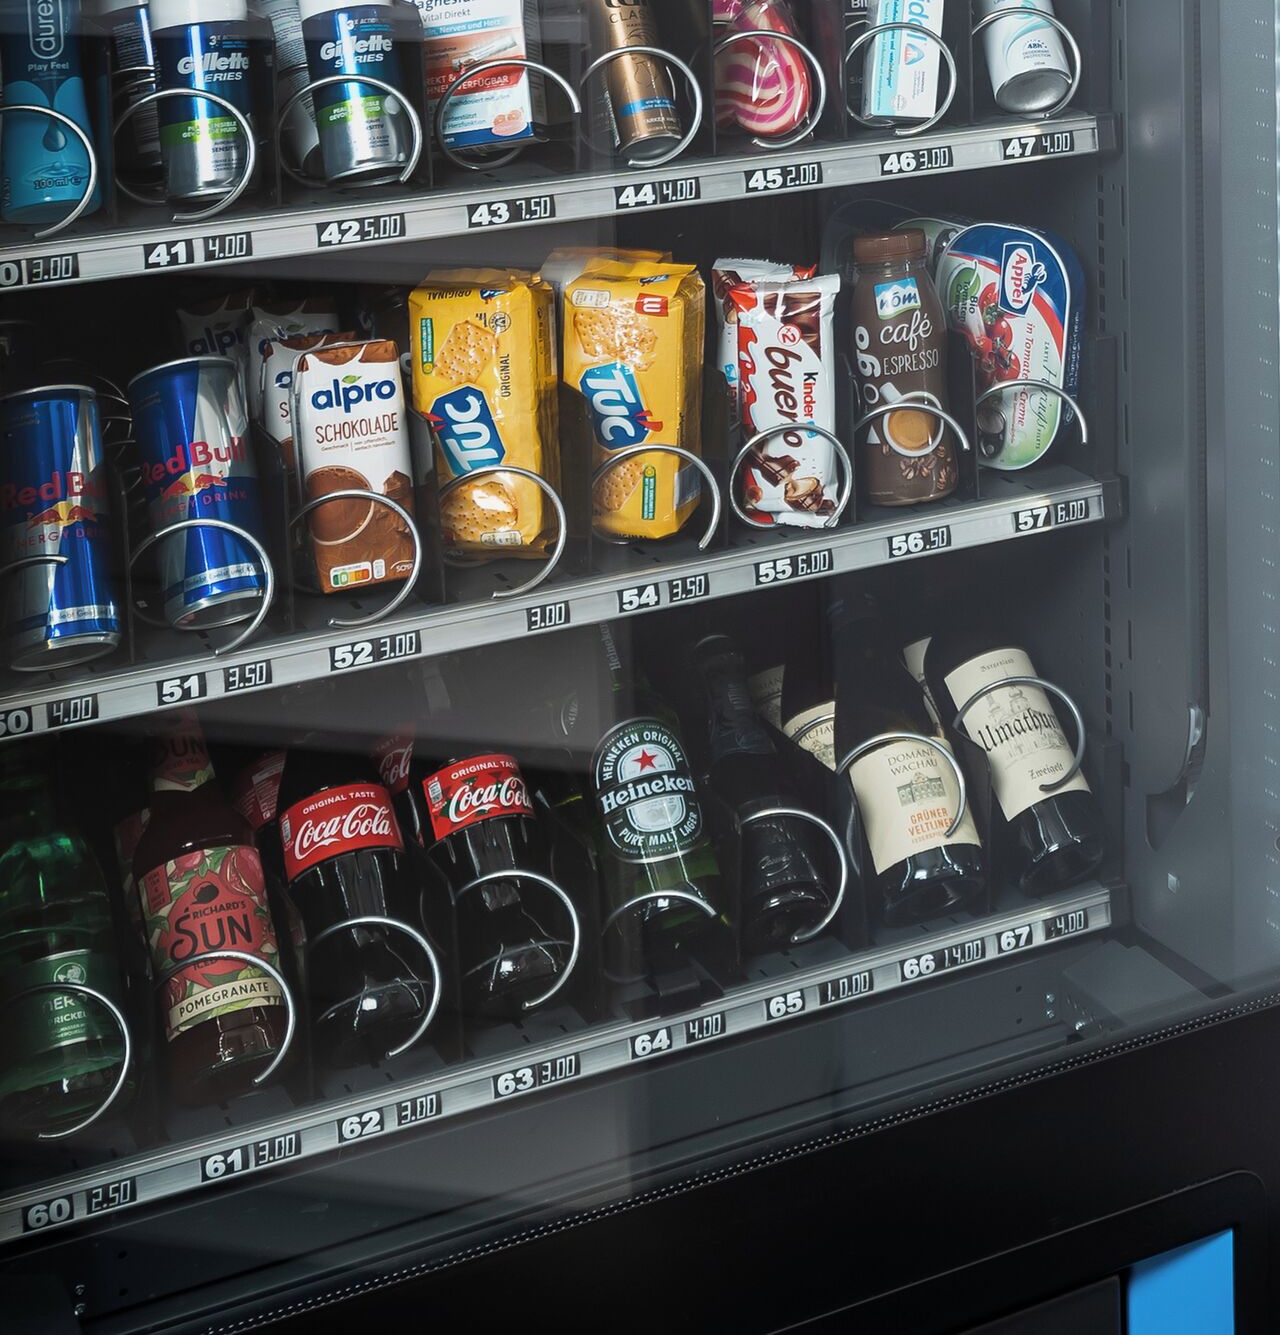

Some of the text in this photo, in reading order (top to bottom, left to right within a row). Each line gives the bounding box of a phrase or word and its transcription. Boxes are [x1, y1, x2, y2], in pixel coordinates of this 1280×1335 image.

[422, 8, 471, 22] Vital Direkt
[440, 24, 465, 35] Nerven
[28, 60, 69, 73] Play Feel
[1005, 133, 1071, 158] 47 4.00
[883, 148, 950, 174] 46 3.00
[34, 178, 54, 189] 100
[748, 170, 784, 189] 45
[618, 179, 696, 207] 44 4.00
[471, 203, 510, 226] 43
[320, 215, 400, 244] 42 5.00
[148, 234, 247, 267] 41 4.00
[1011, 253, 1029, 306] Appel
[969, 295, 979, 315] Bio
[880, 309, 933, 351] café
[501, 353, 511, 398] ORIGINAL
[884, 348, 939, 377] ESPRESSO
[311, 377, 396, 413] alpro
[315, 412, 399, 444] SCHOKOLADE
[190, 436, 246, 467] Bull
[1018, 507, 1048, 529] 57
[892, 534, 925, 557] 56
[758, 551, 829, 583] 55 6.00
[622, 587, 659, 611] 54
[334, 633, 416, 668] 52 3.00
[162, 664, 266, 703] 51 3.50
[52, 697, 92, 723] 4.00
[602, 730, 684, 781] HEINEKEN ORIGINAL
[890, 758, 938, 777] WACHAU
[450, 761, 498, 780] ORIGINAL
[302, 790, 376, 814] ORIGINAL TASTE
[600, 774, 696, 815] Heineken
[910, 806, 949, 825] GRÜNER
[294, 804, 392, 860] Coca-Cola
[619, 827, 678, 847] PURE MALT
[193, 900, 247, 920] RICHARD'S
[170, 907, 253, 962] SUN
[1000, 926, 1031, 951] 67
[903, 955, 936, 979] 66
[179, 982, 270, 1017] POMEGRANATE
[769, 993, 803, 1017] 65
[635, 1031, 671, 1055] 64
[497, 1068, 534, 1095] 63
[342, 1113, 381, 1140] 62
[206, 1149, 243, 1178] 61
[27, 1199, 71, 1228] 60
